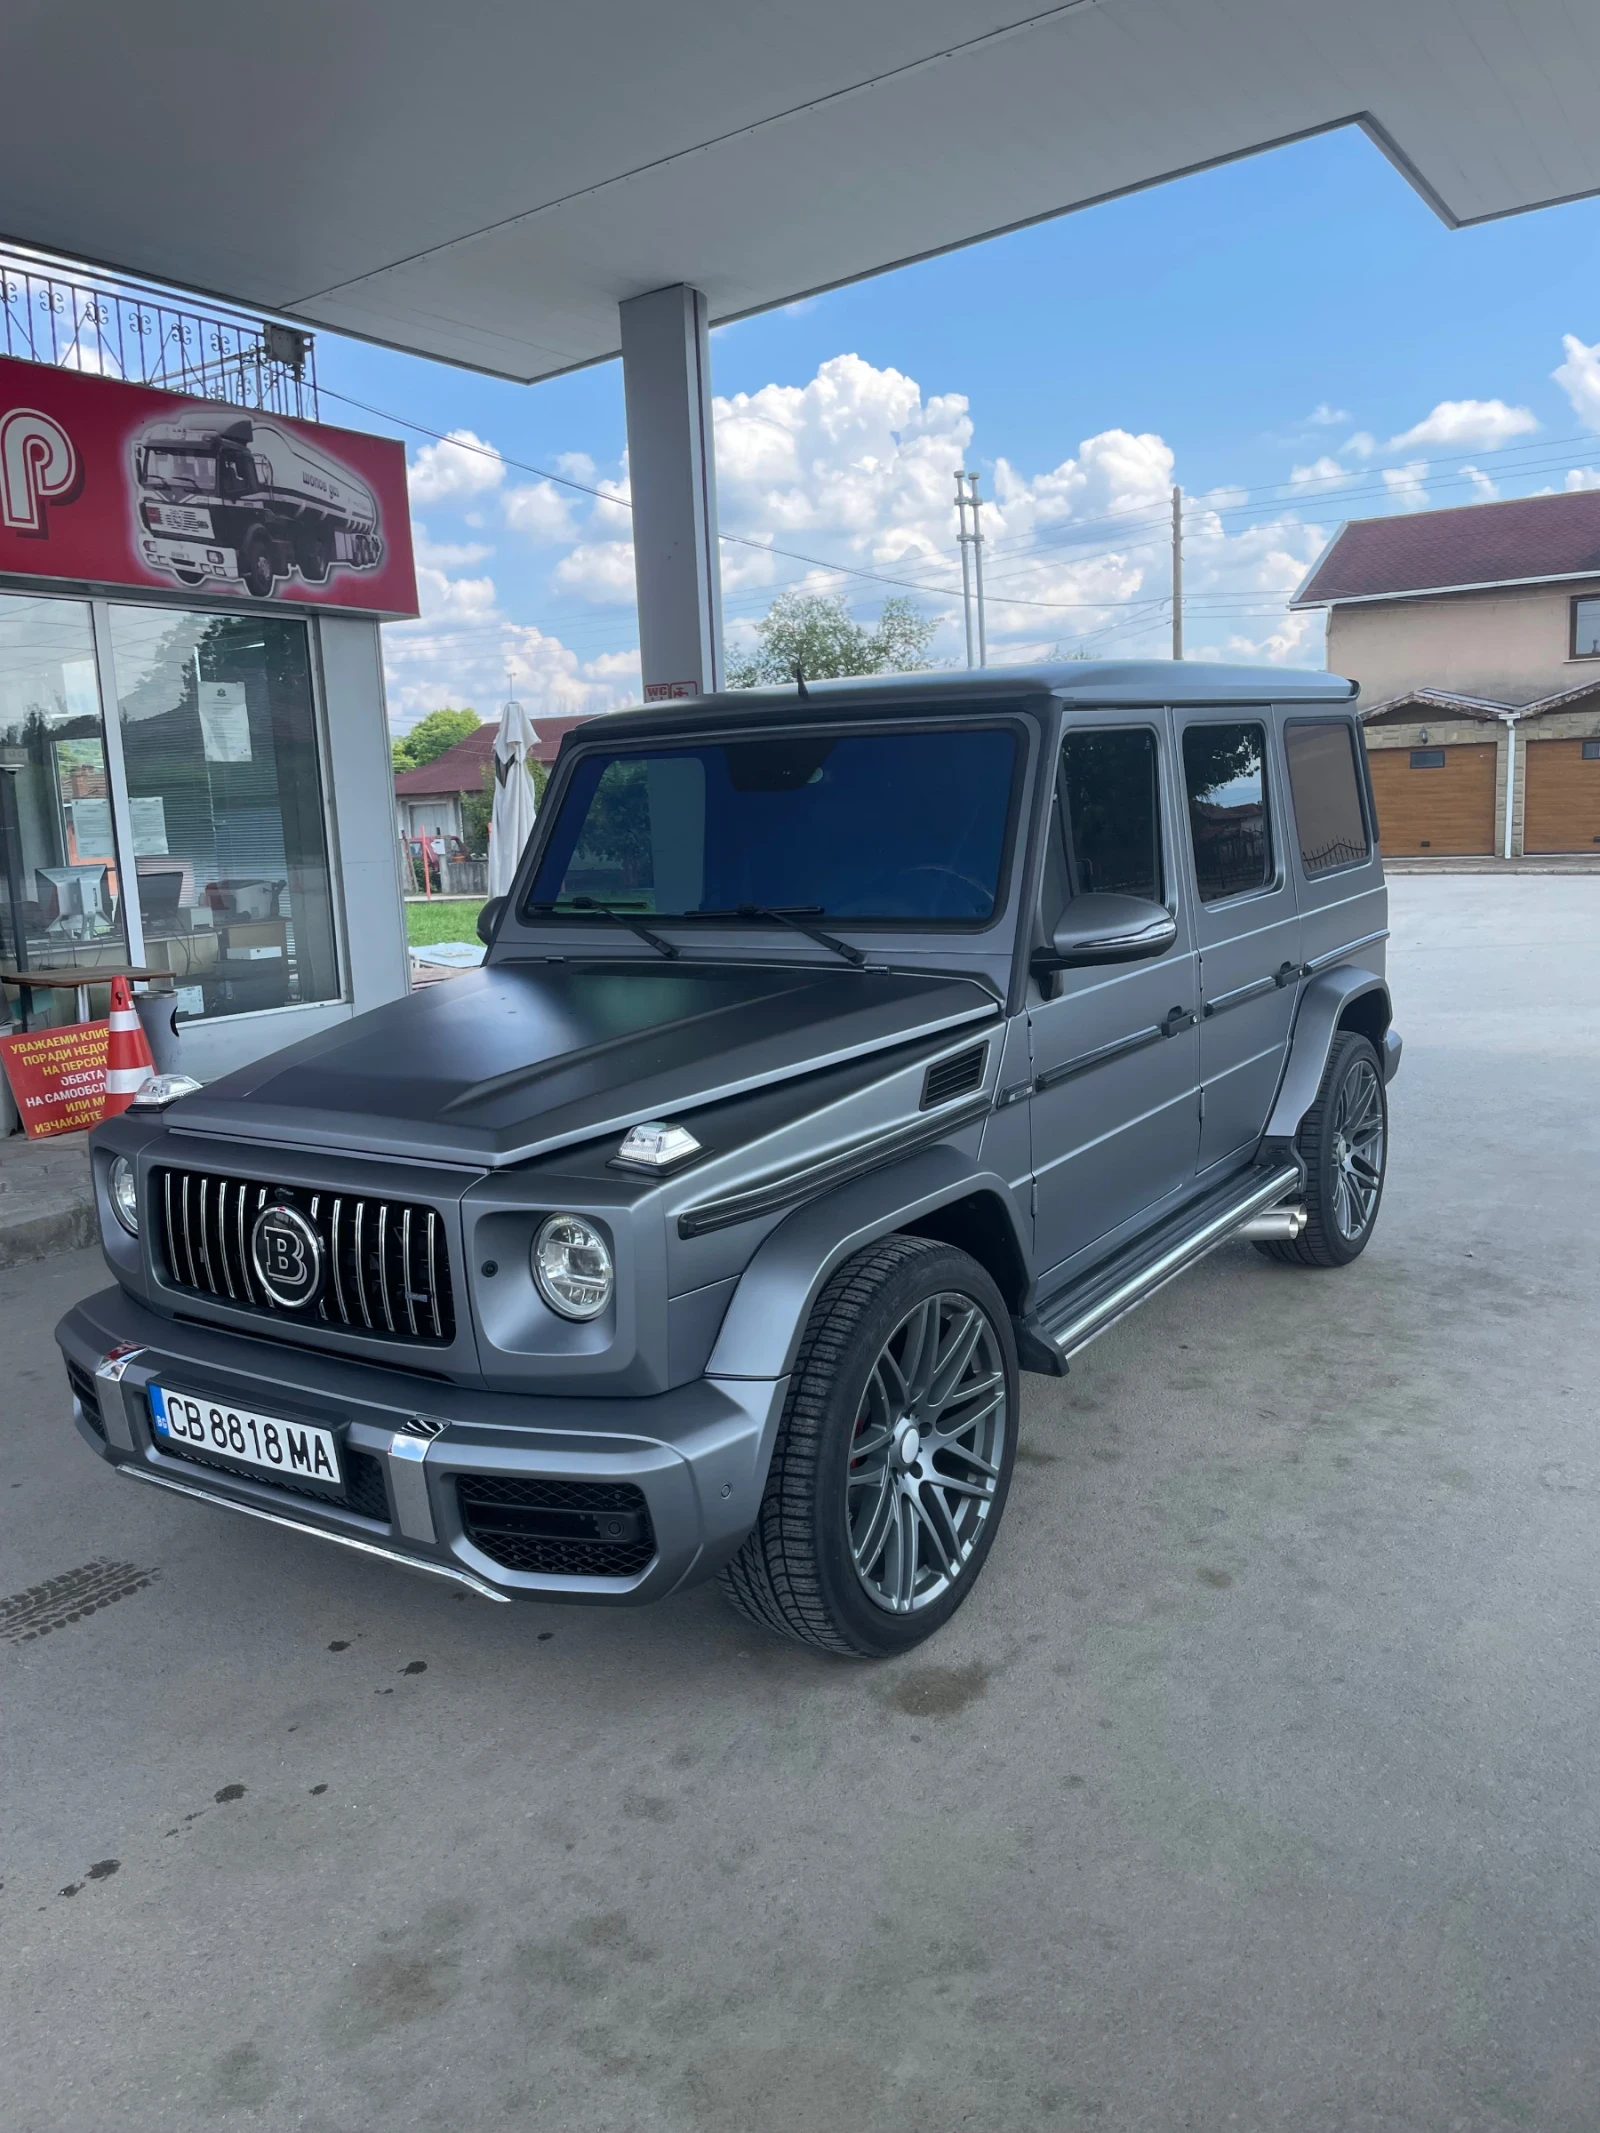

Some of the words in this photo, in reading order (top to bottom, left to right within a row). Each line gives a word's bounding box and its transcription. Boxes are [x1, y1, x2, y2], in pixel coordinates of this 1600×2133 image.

[647, 687, 667, 696] WC
[10, 1033, 78, 1054] УВАЖАЕМИ
[22, 1048, 72, 1066] ПОРАДИ
[42, 1065, 60, 1076] НА
[61, 1069, 104, 1086] ОБЕКТА
[25, 1096, 43, 1108] НА
[65, 1100, 91, 1113] ИЛИ
[34, 1111, 103, 1133] ИЗЧАКАЙТЕ
[263, 1225, 308, 1286] B
[156, 1415, 168, 1429] BG
[209, 1408, 283, 1464] 8818
